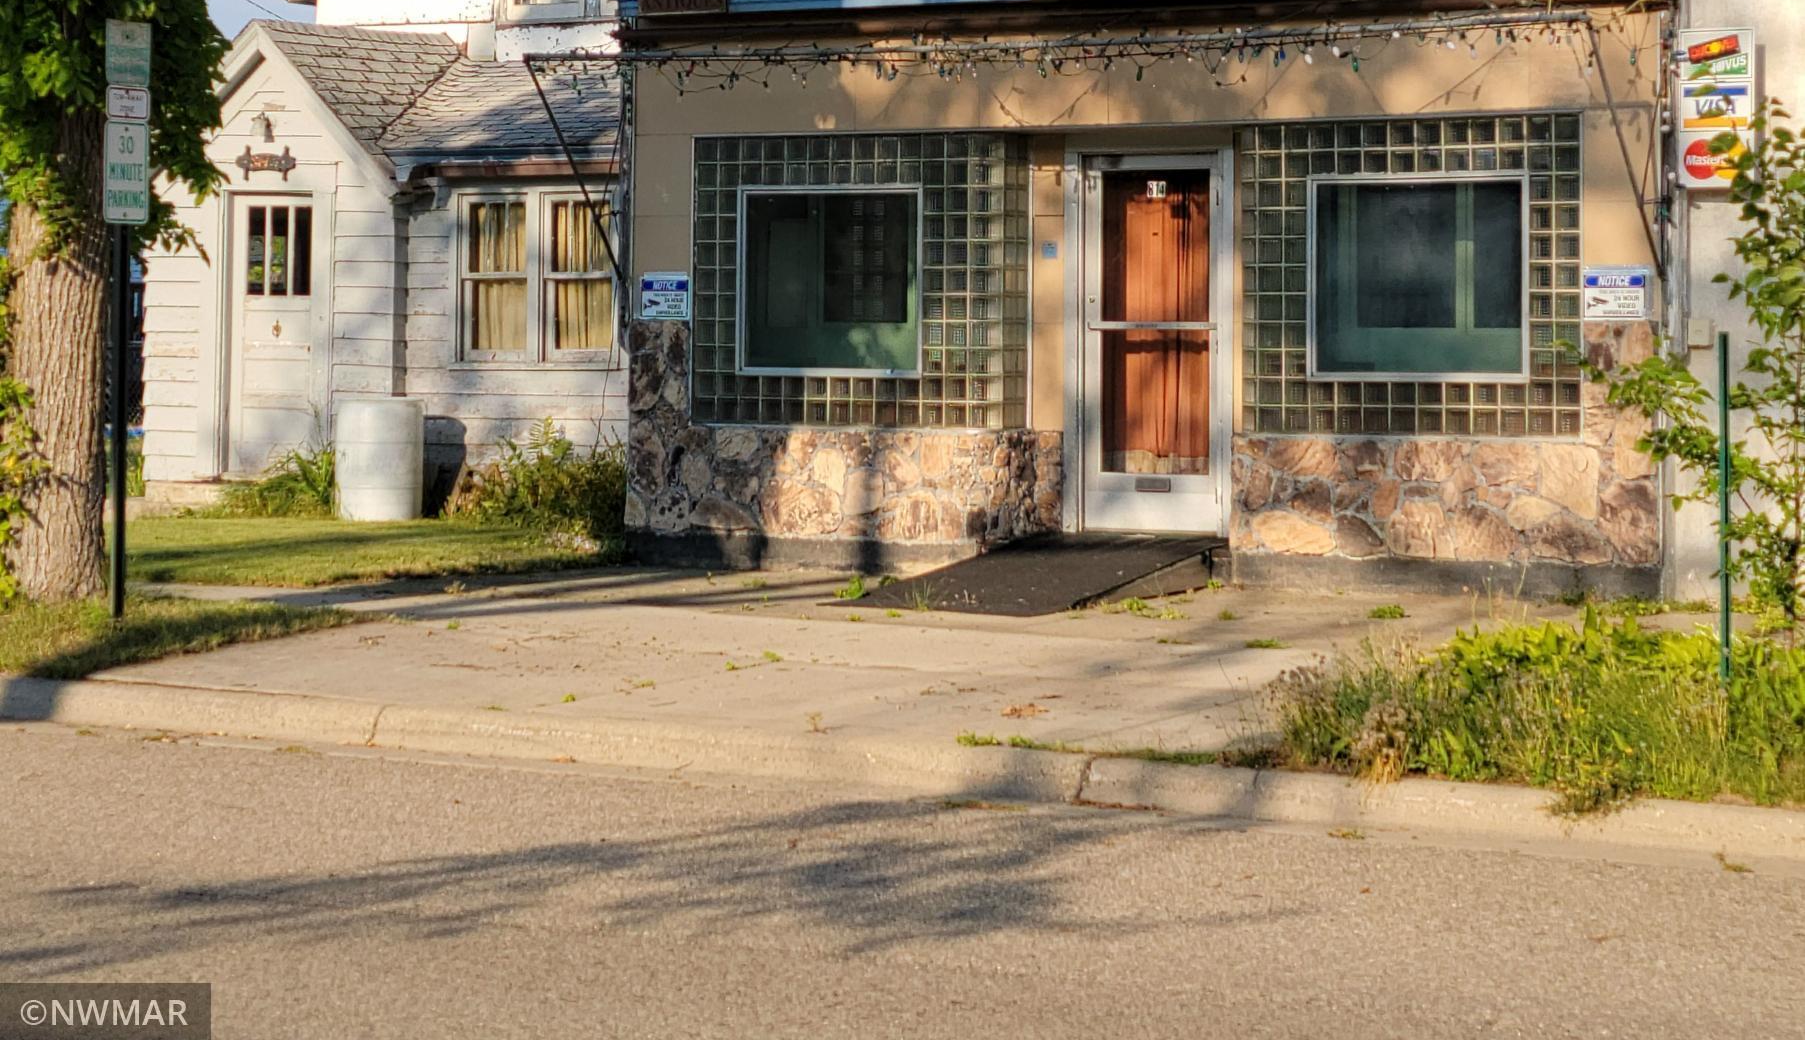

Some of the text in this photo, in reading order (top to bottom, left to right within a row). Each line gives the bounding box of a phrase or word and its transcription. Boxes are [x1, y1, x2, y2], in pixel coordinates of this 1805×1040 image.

[1695, 98, 1736, 115] VISA
[118, 135, 134, 154] 30
[108, 163, 143, 181] MINUTE
[1147, 181, 1166, 198] 814
[107, 189, 144, 209] PARKING
[653, 280, 677, 290] NOTICE
[1598, 275, 1630, 287] NOTICE
